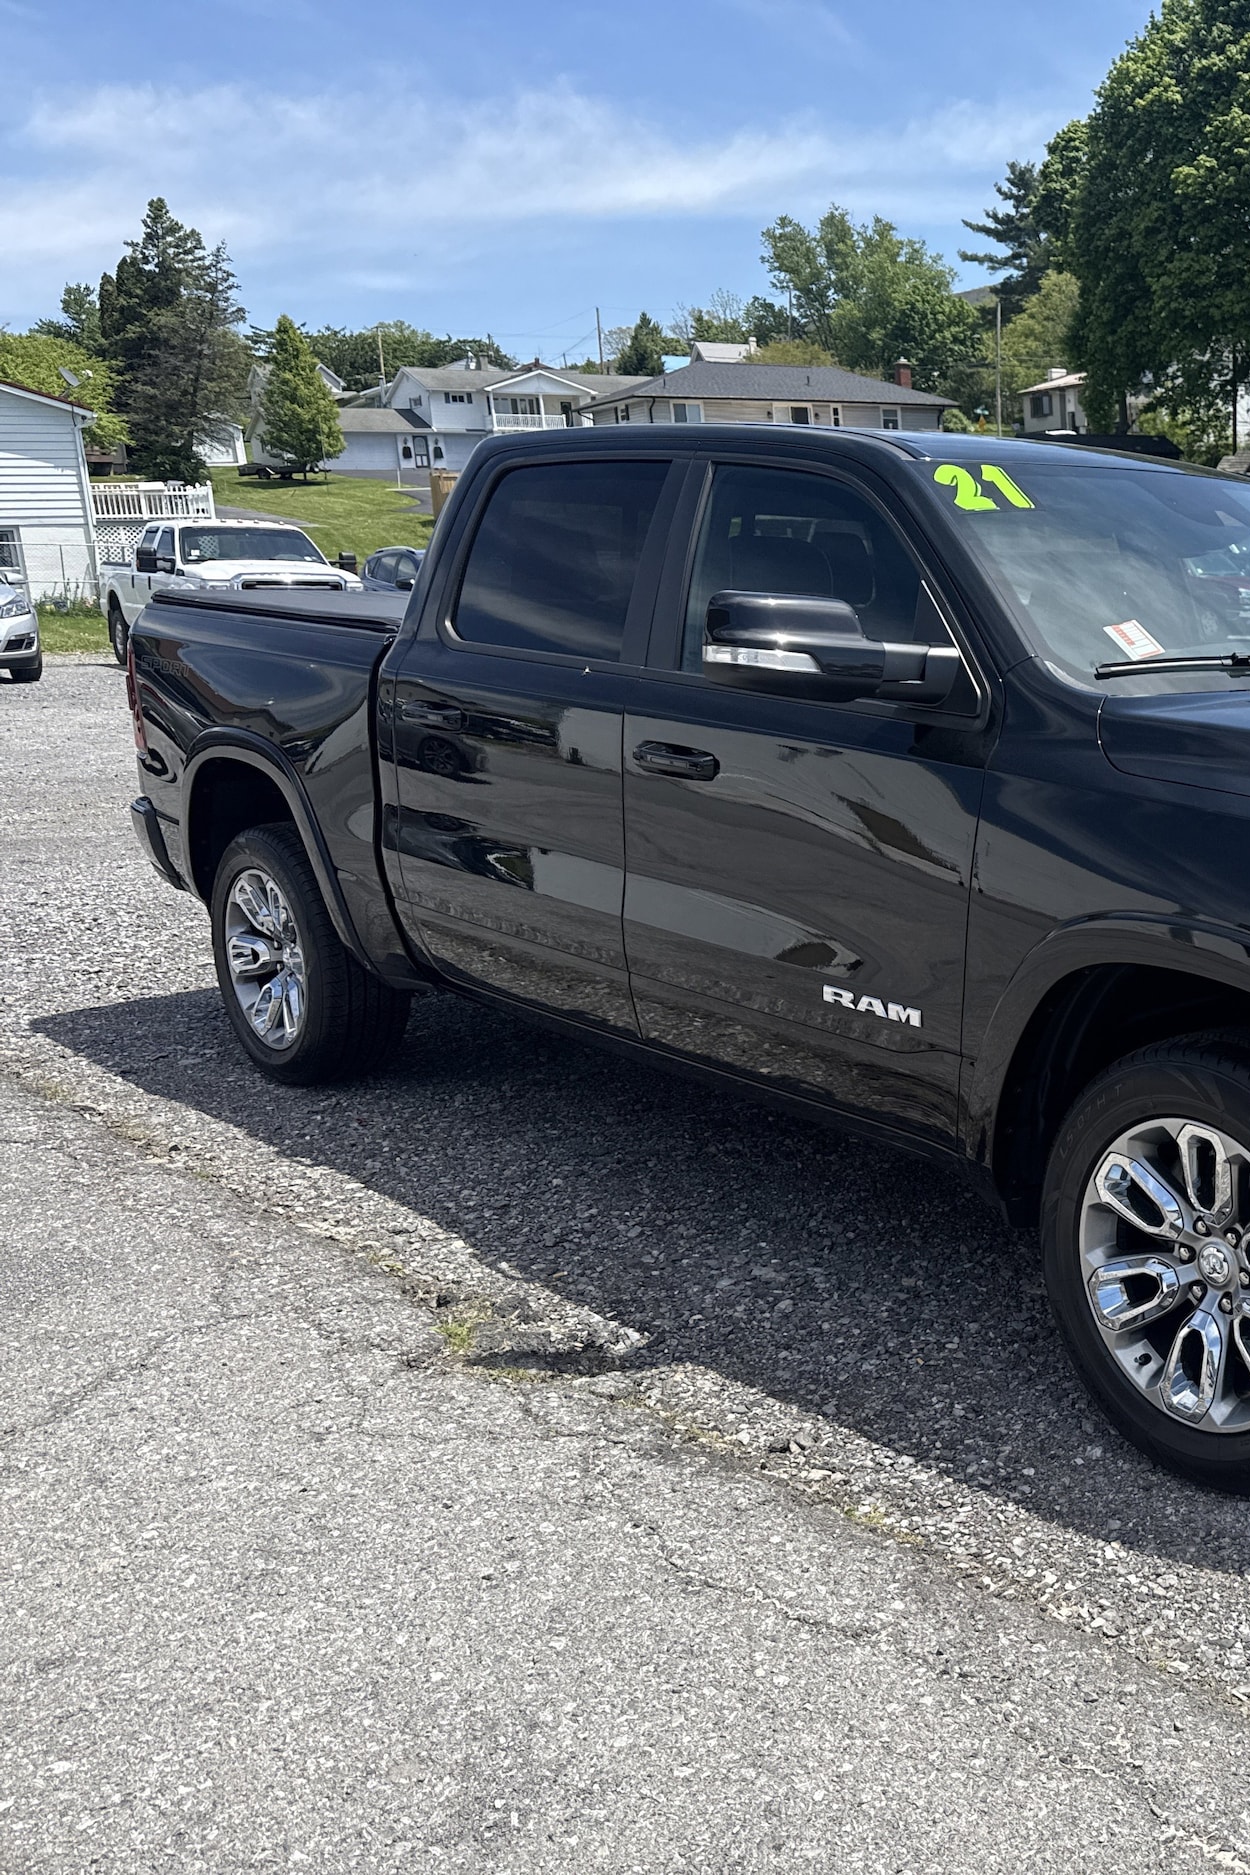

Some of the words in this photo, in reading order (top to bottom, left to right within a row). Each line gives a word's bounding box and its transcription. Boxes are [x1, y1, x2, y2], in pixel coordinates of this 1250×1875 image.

[933, 464, 1035, 511] 21
[141, 655, 189, 677] SPORT
[823, 984, 922, 1028] RAM
